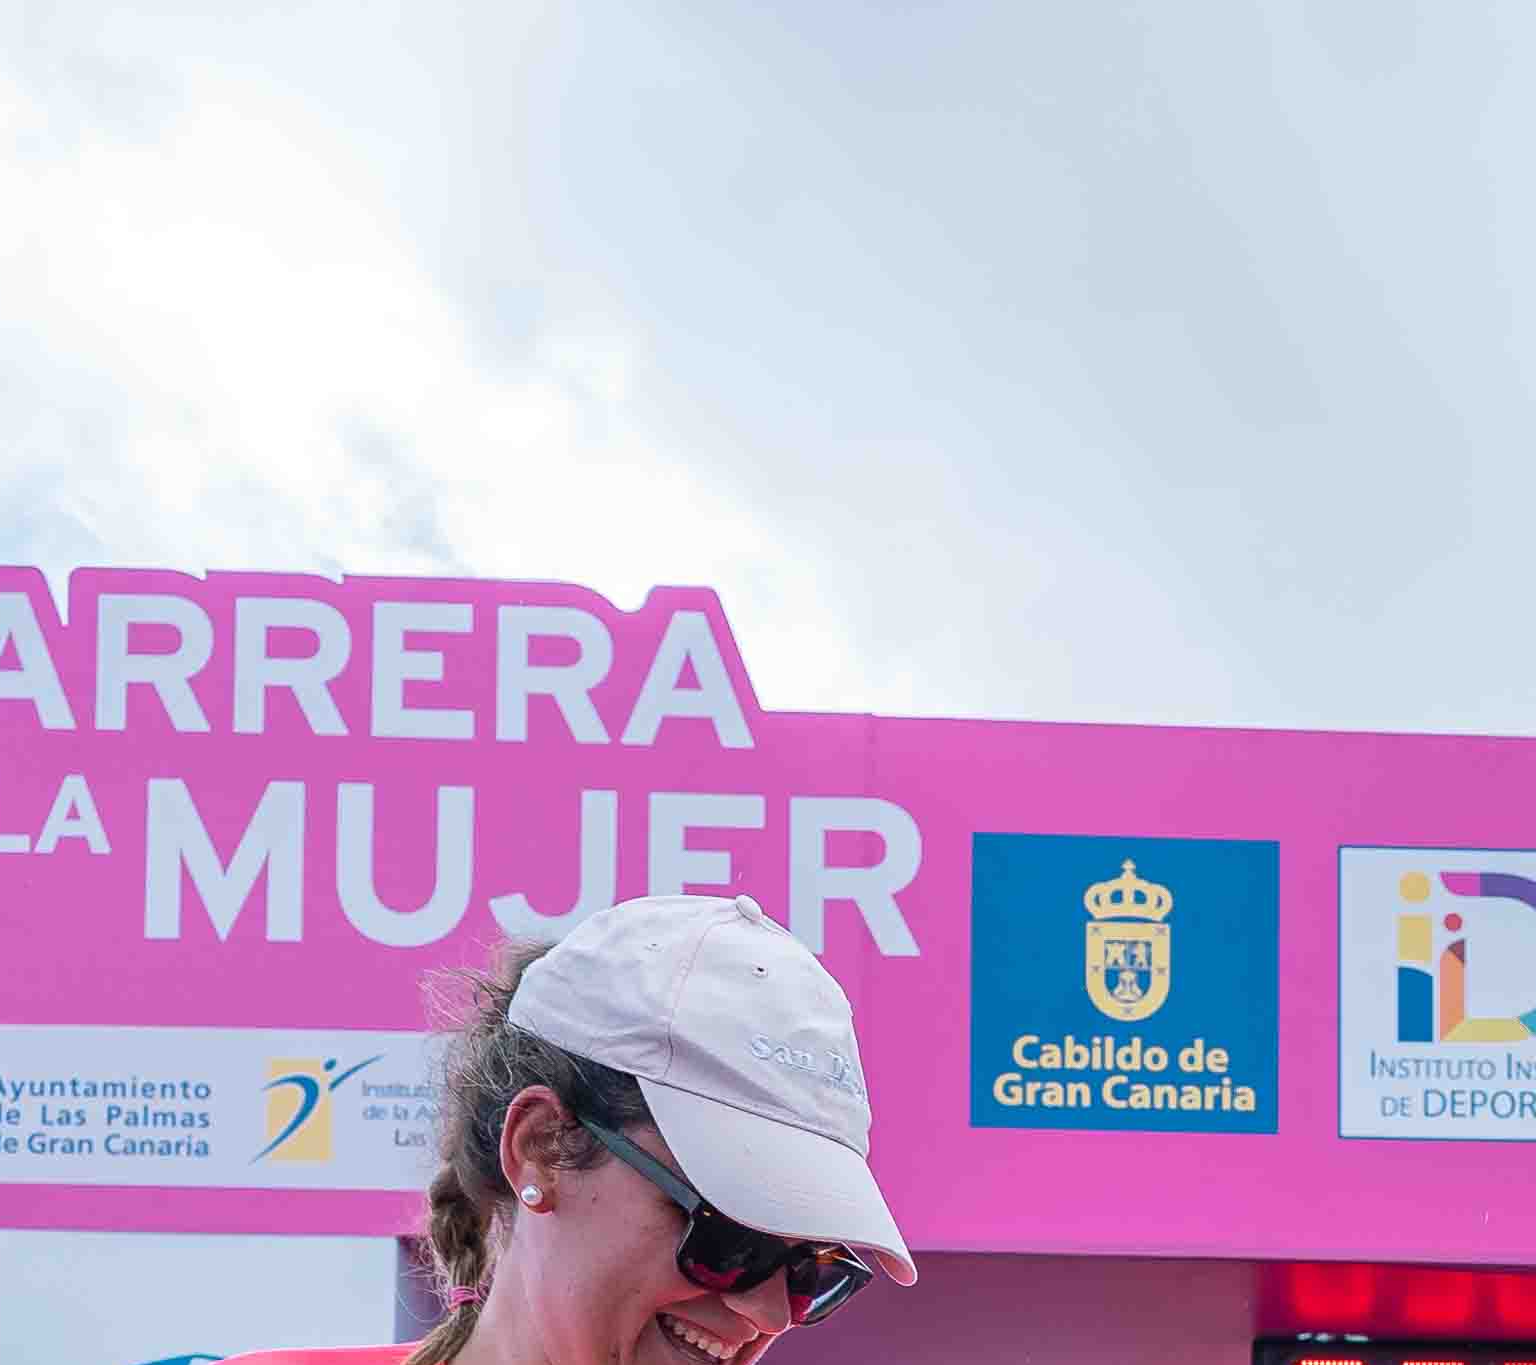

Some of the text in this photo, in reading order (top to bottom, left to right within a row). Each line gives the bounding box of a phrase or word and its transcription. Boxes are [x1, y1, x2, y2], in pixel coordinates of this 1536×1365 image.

[143, 777, 923, 957] MUJER
[1011, 1034, 1231, 1074] Cabildo de
[992, 1072, 1257, 1114] Gran Canaria
[41, 1105, 87, 1127] Las
[106, 1105, 211, 1128] Palmas
[27, 1133, 93, 1156] Gran
[104, 1134, 211, 1158] Canaria
